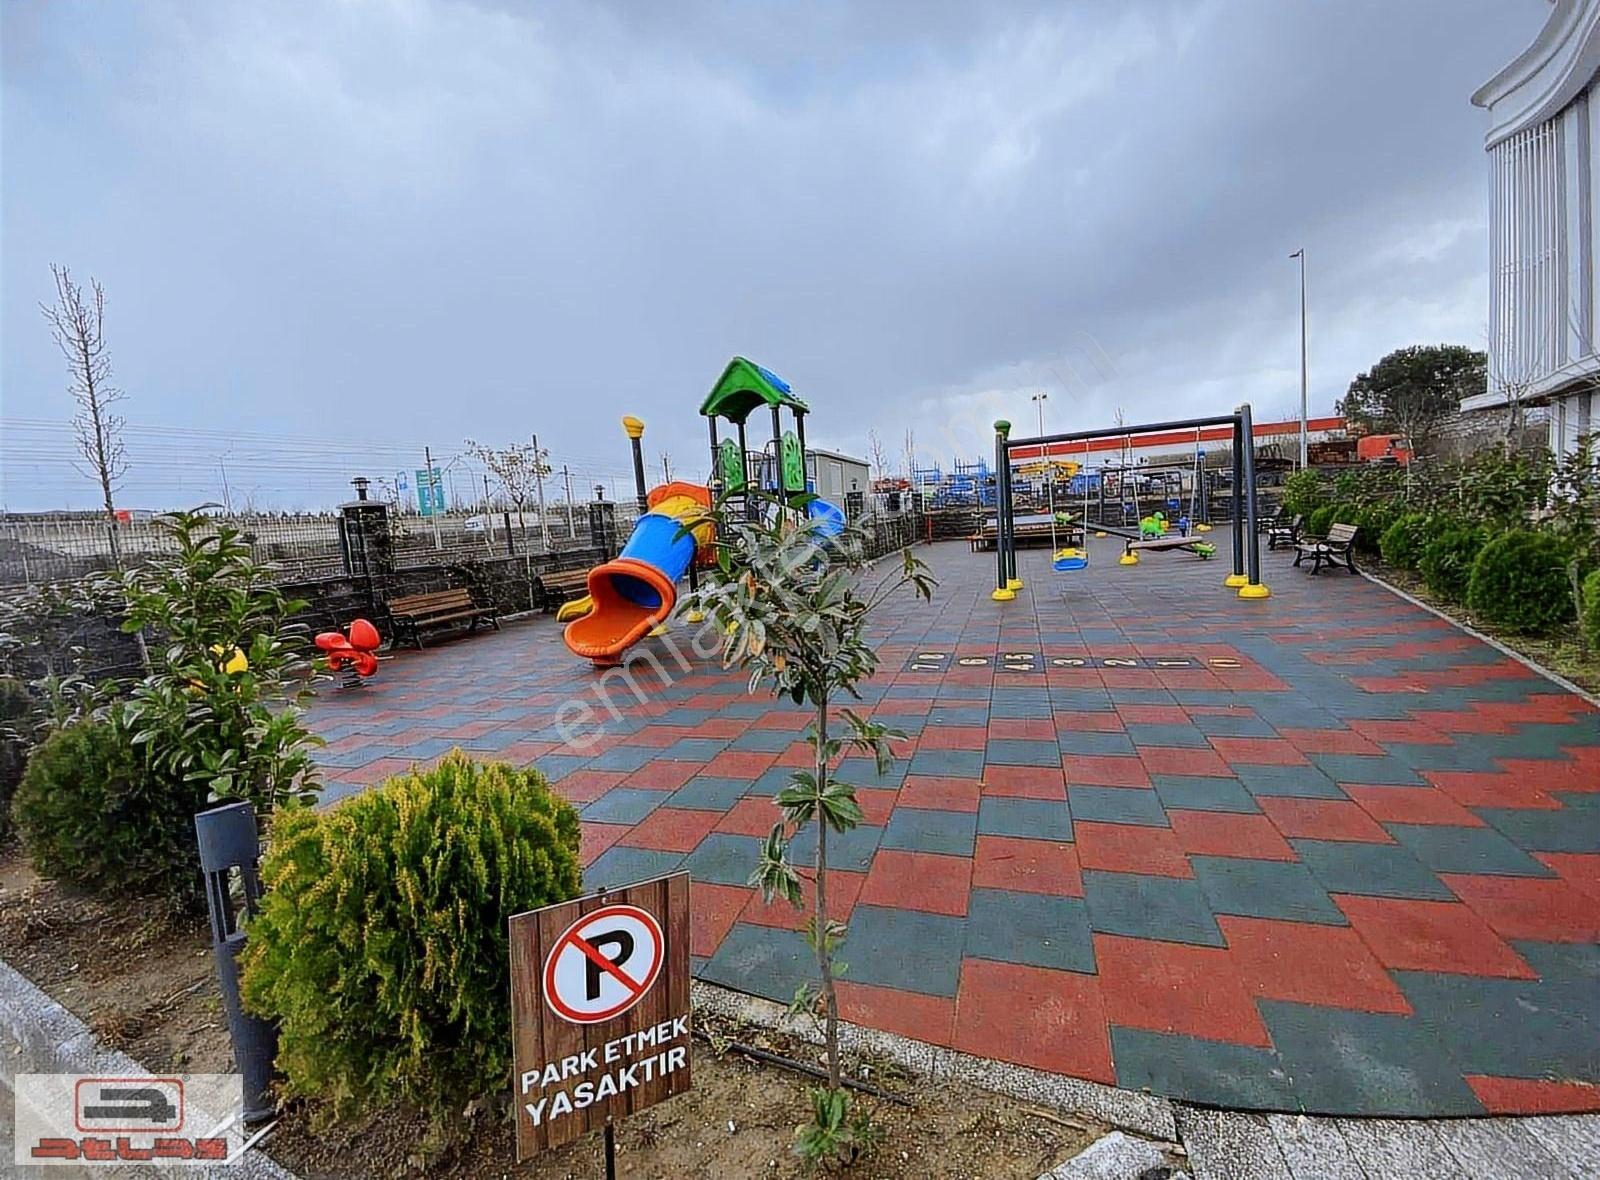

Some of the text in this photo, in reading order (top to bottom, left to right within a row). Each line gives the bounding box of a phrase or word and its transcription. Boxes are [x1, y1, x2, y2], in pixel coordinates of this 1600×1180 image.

[585, 929, 634, 1001] P
[521, 1014, 688, 1095] PARK ETMEK
[525, 1046, 687, 1127] YASAKTIR
